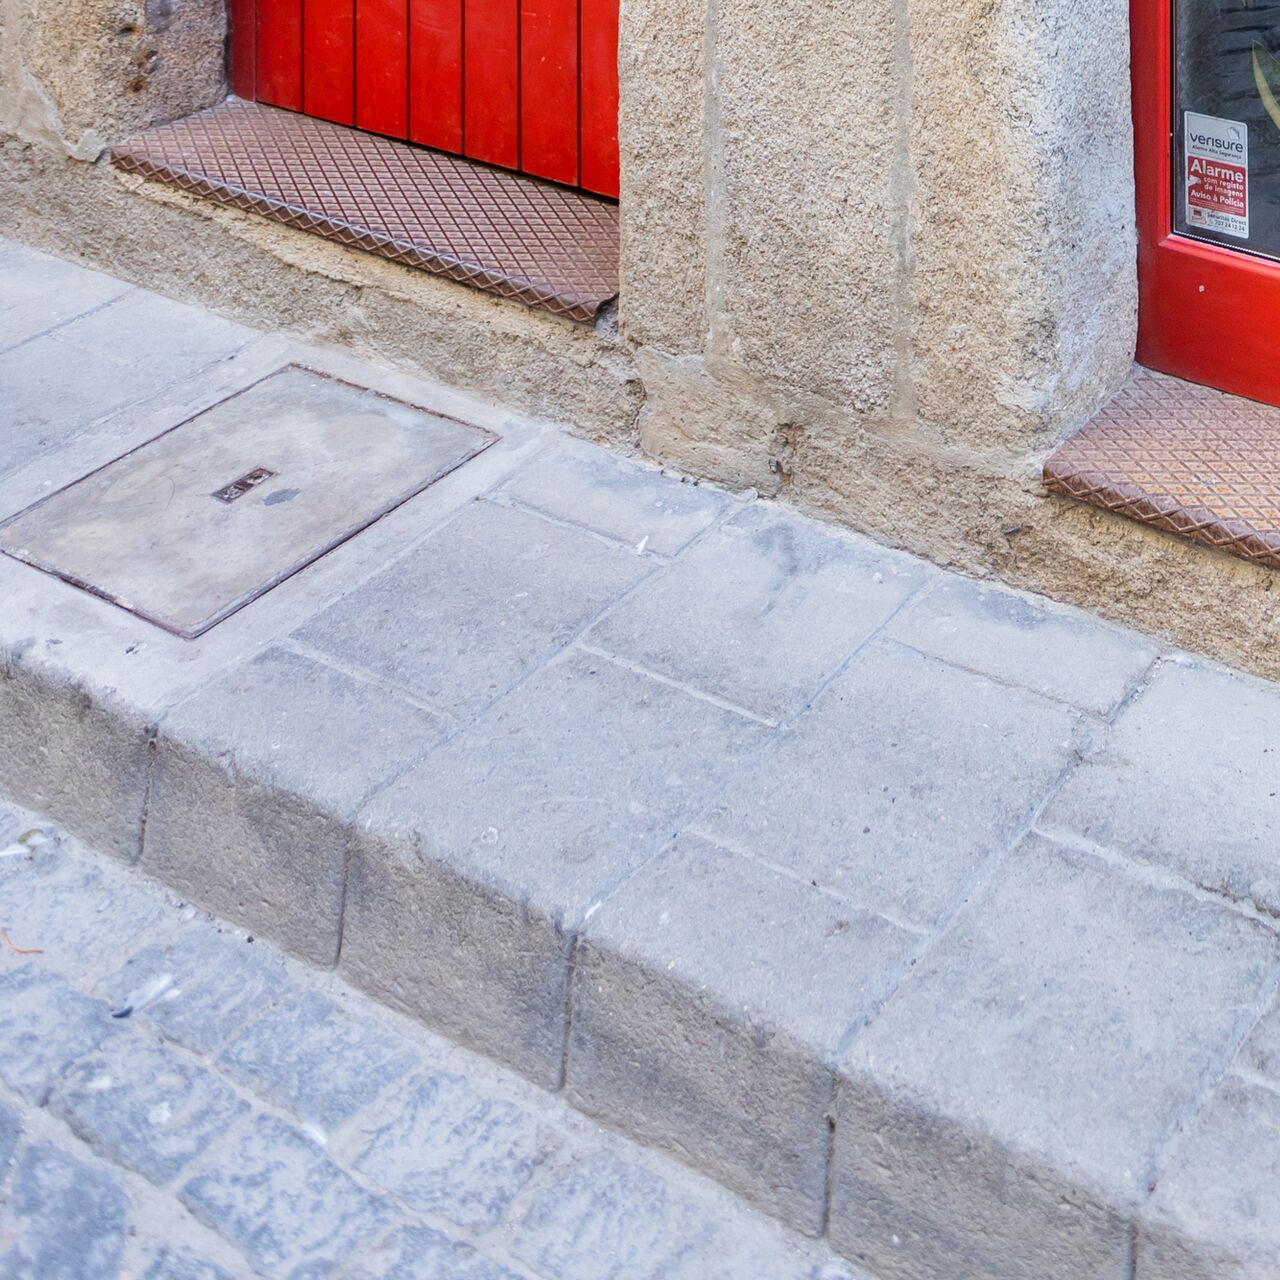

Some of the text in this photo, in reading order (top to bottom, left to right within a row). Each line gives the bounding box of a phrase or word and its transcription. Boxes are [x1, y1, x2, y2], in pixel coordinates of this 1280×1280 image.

[1190, 133, 1243, 153] verisure
[1191, 159, 1244, 182] Alarme
[1203, 176, 1244, 191] com registo
[1204, 183, 1244, 198] de imagens
[1190, 190, 1211, 200] Aviso
